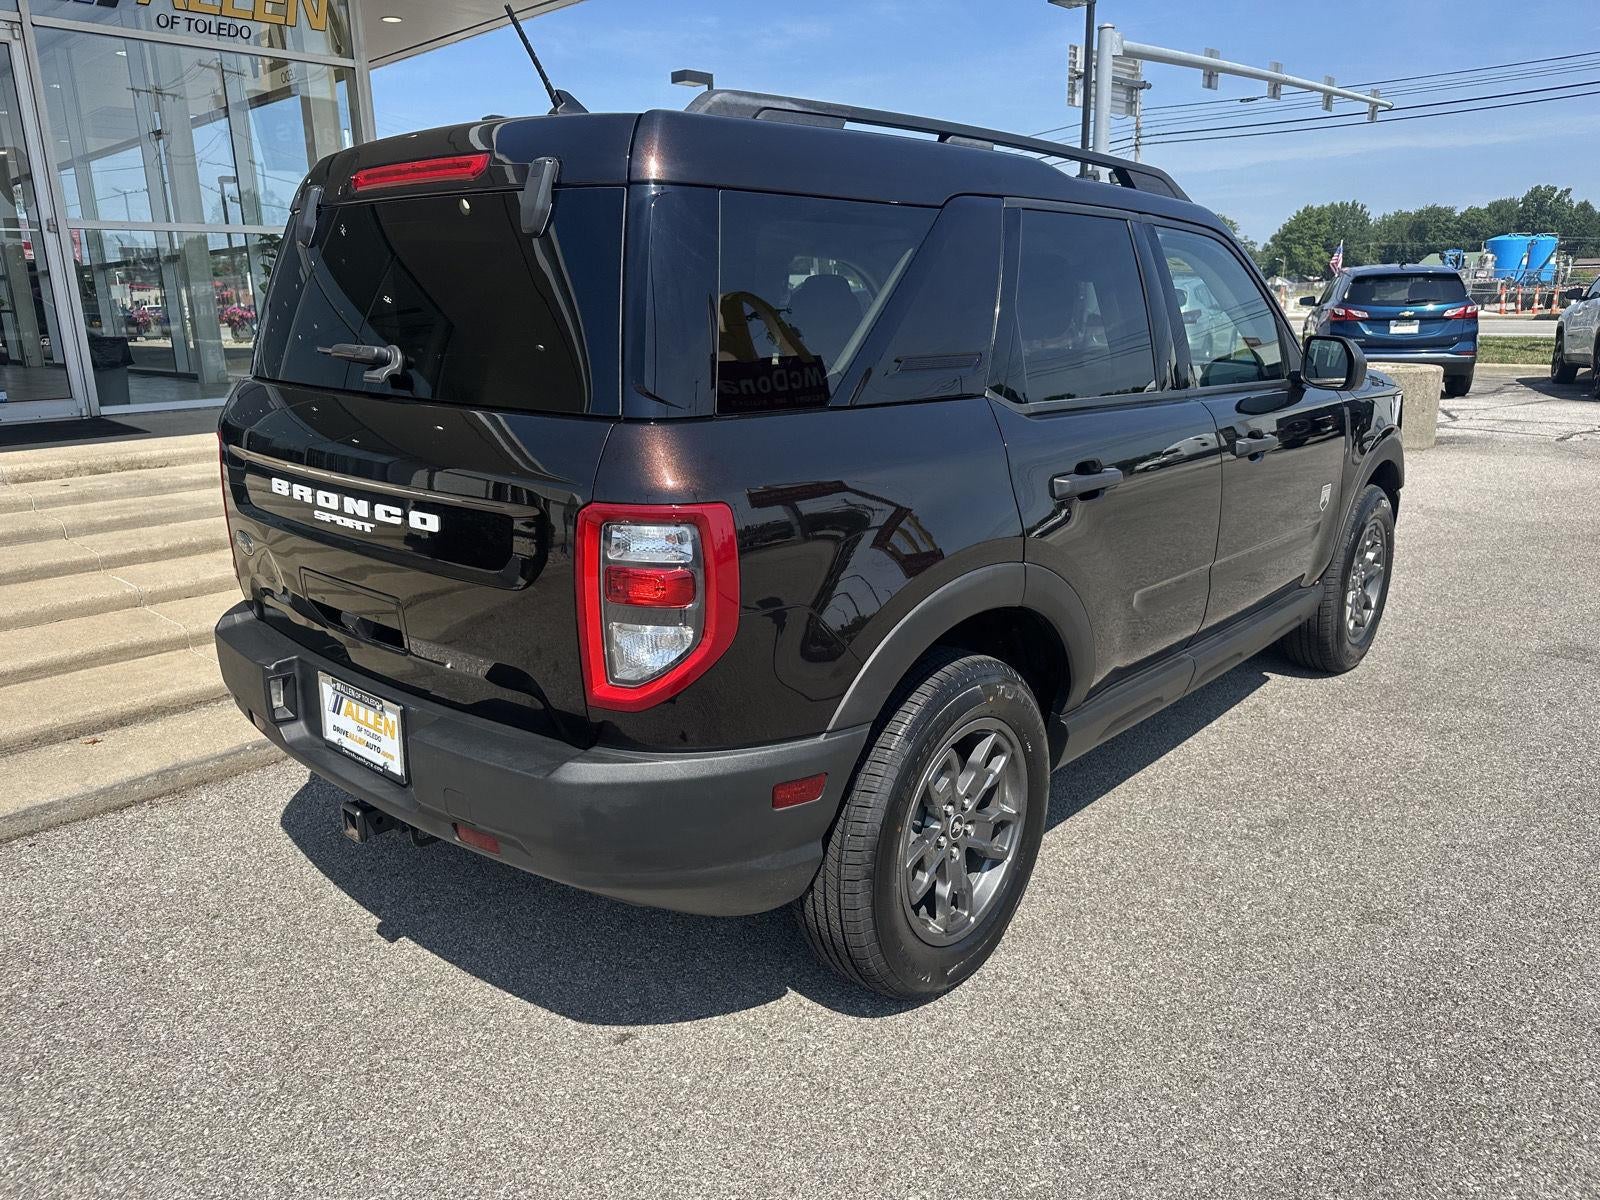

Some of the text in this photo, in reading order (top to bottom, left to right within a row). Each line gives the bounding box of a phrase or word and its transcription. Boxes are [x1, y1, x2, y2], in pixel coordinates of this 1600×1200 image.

[156, 13, 252, 40] OF TOLEDO
[271, 477, 442, 533] BRONCO
[313, 510, 376, 533] SPORT
[340, 684, 355, 697] ALLEN
[343, 699, 396, 740] ALLEN
[356, 725, 382, 743] OF TOLEDO
